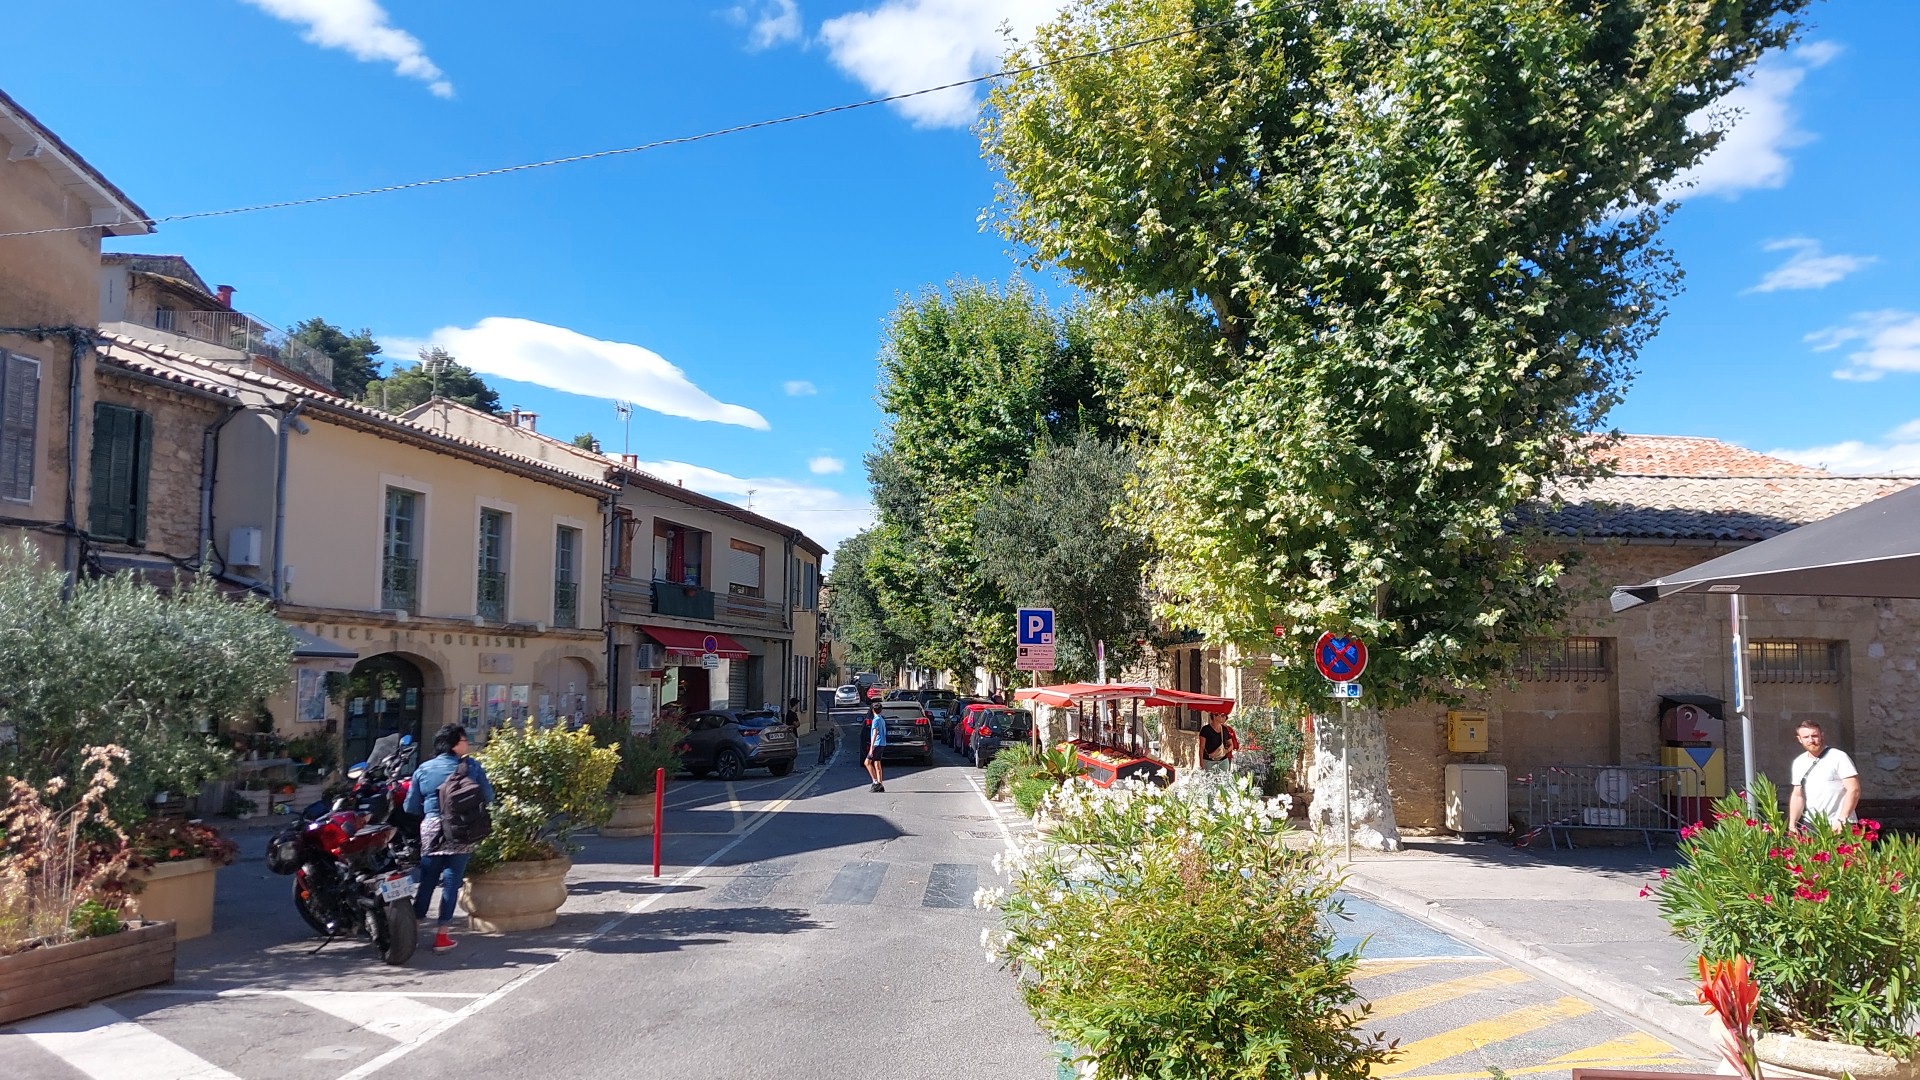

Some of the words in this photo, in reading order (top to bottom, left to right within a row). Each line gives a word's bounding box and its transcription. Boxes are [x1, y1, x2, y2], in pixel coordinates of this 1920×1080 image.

[1028, 615, 1045, 639] P
[429, 633, 526, 649] TOURISME
[820, 642, 829, 669] TABAC
